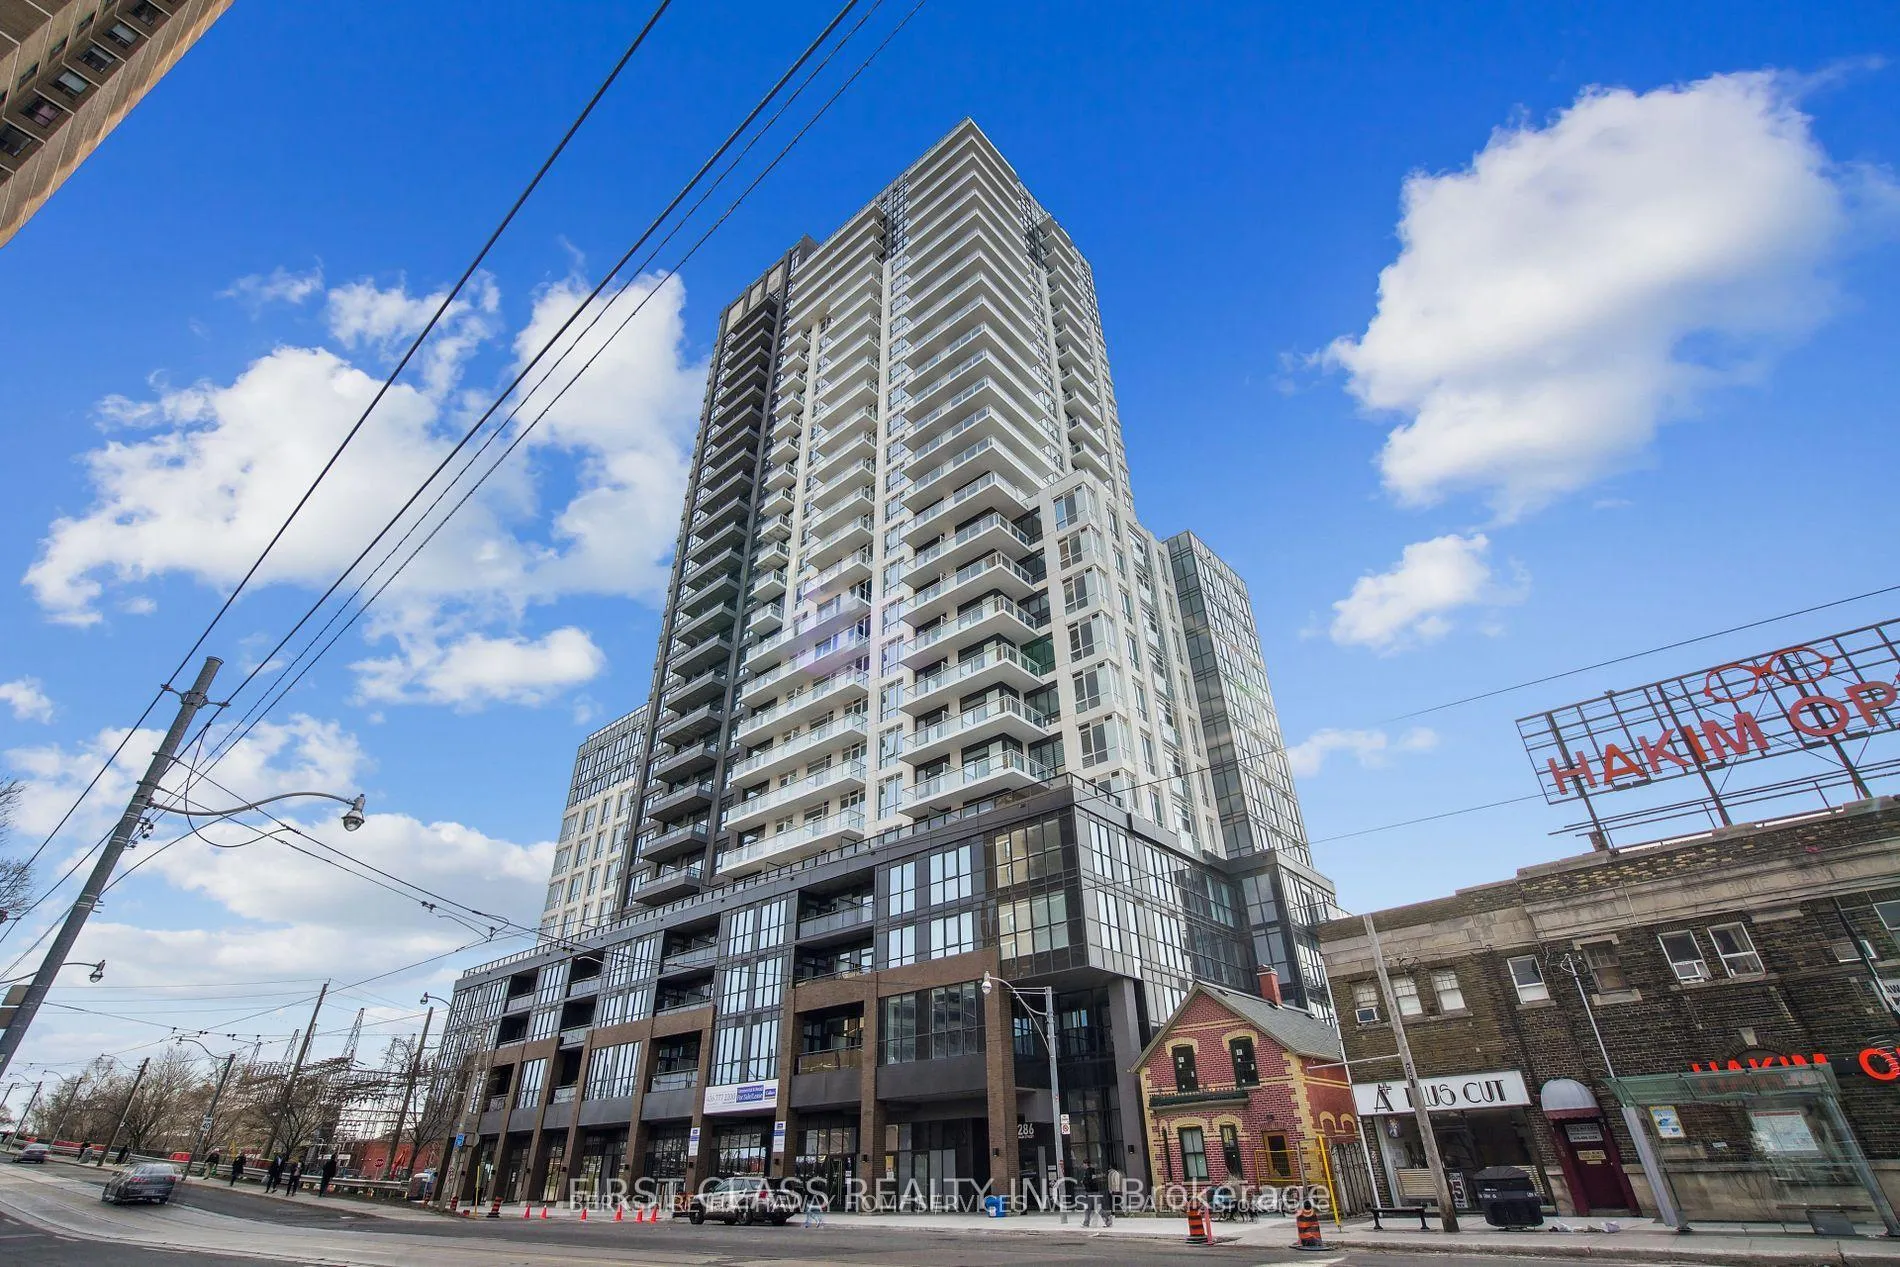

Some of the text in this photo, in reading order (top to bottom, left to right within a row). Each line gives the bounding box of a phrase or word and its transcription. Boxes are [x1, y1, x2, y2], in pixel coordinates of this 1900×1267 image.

[1547, 678, 1900, 795] HAKIM OP
[1858, 1047, 1900, 1081] O
[1462, 1079, 1507, 1104] CUT
[1017, 1123, 1035, 1135] 286
